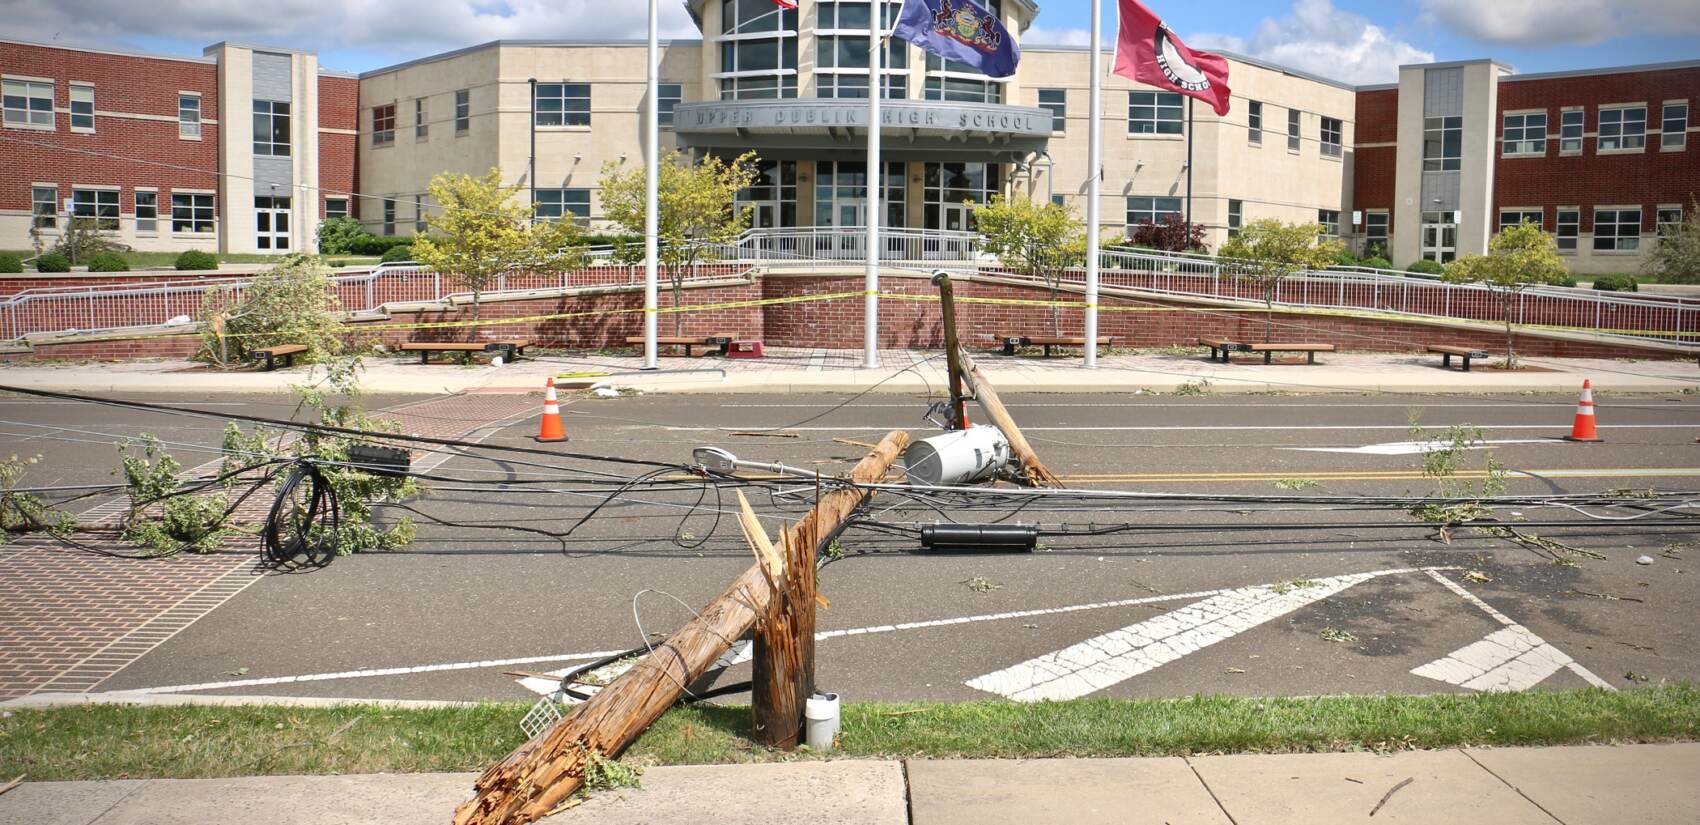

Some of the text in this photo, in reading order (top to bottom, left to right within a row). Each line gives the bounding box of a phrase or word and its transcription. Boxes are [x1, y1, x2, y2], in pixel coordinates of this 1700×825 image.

[1156, 55, 1178, 83] HIGH
[697, 110, 1032, 130] UPPER DUBLIN HIGH SCHOOL
